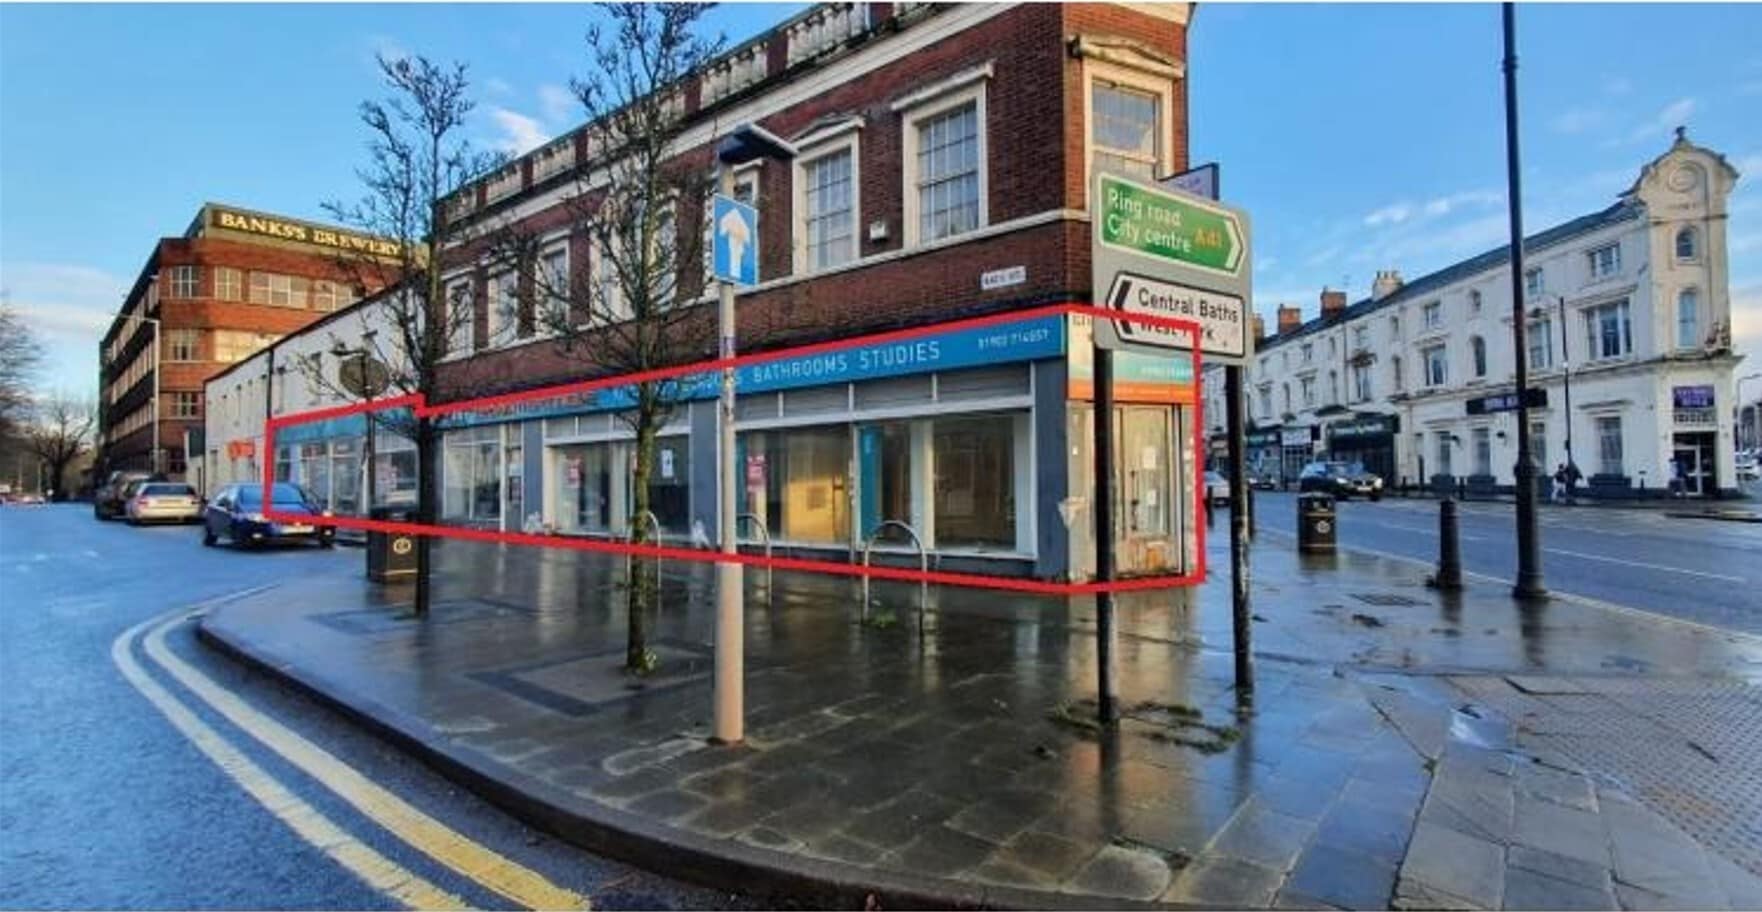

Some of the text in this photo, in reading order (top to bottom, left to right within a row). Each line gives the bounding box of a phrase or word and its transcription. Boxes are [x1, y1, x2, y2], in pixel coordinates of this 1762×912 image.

[1107, 188, 1181, 227] Ring road
[1107, 214, 1192, 253] City centre
[1194, 227, 1222, 248] A41
[1138, 287, 1239, 323] Central Baths
[753, 340, 940, 383] BATHROOMS STUDIES
